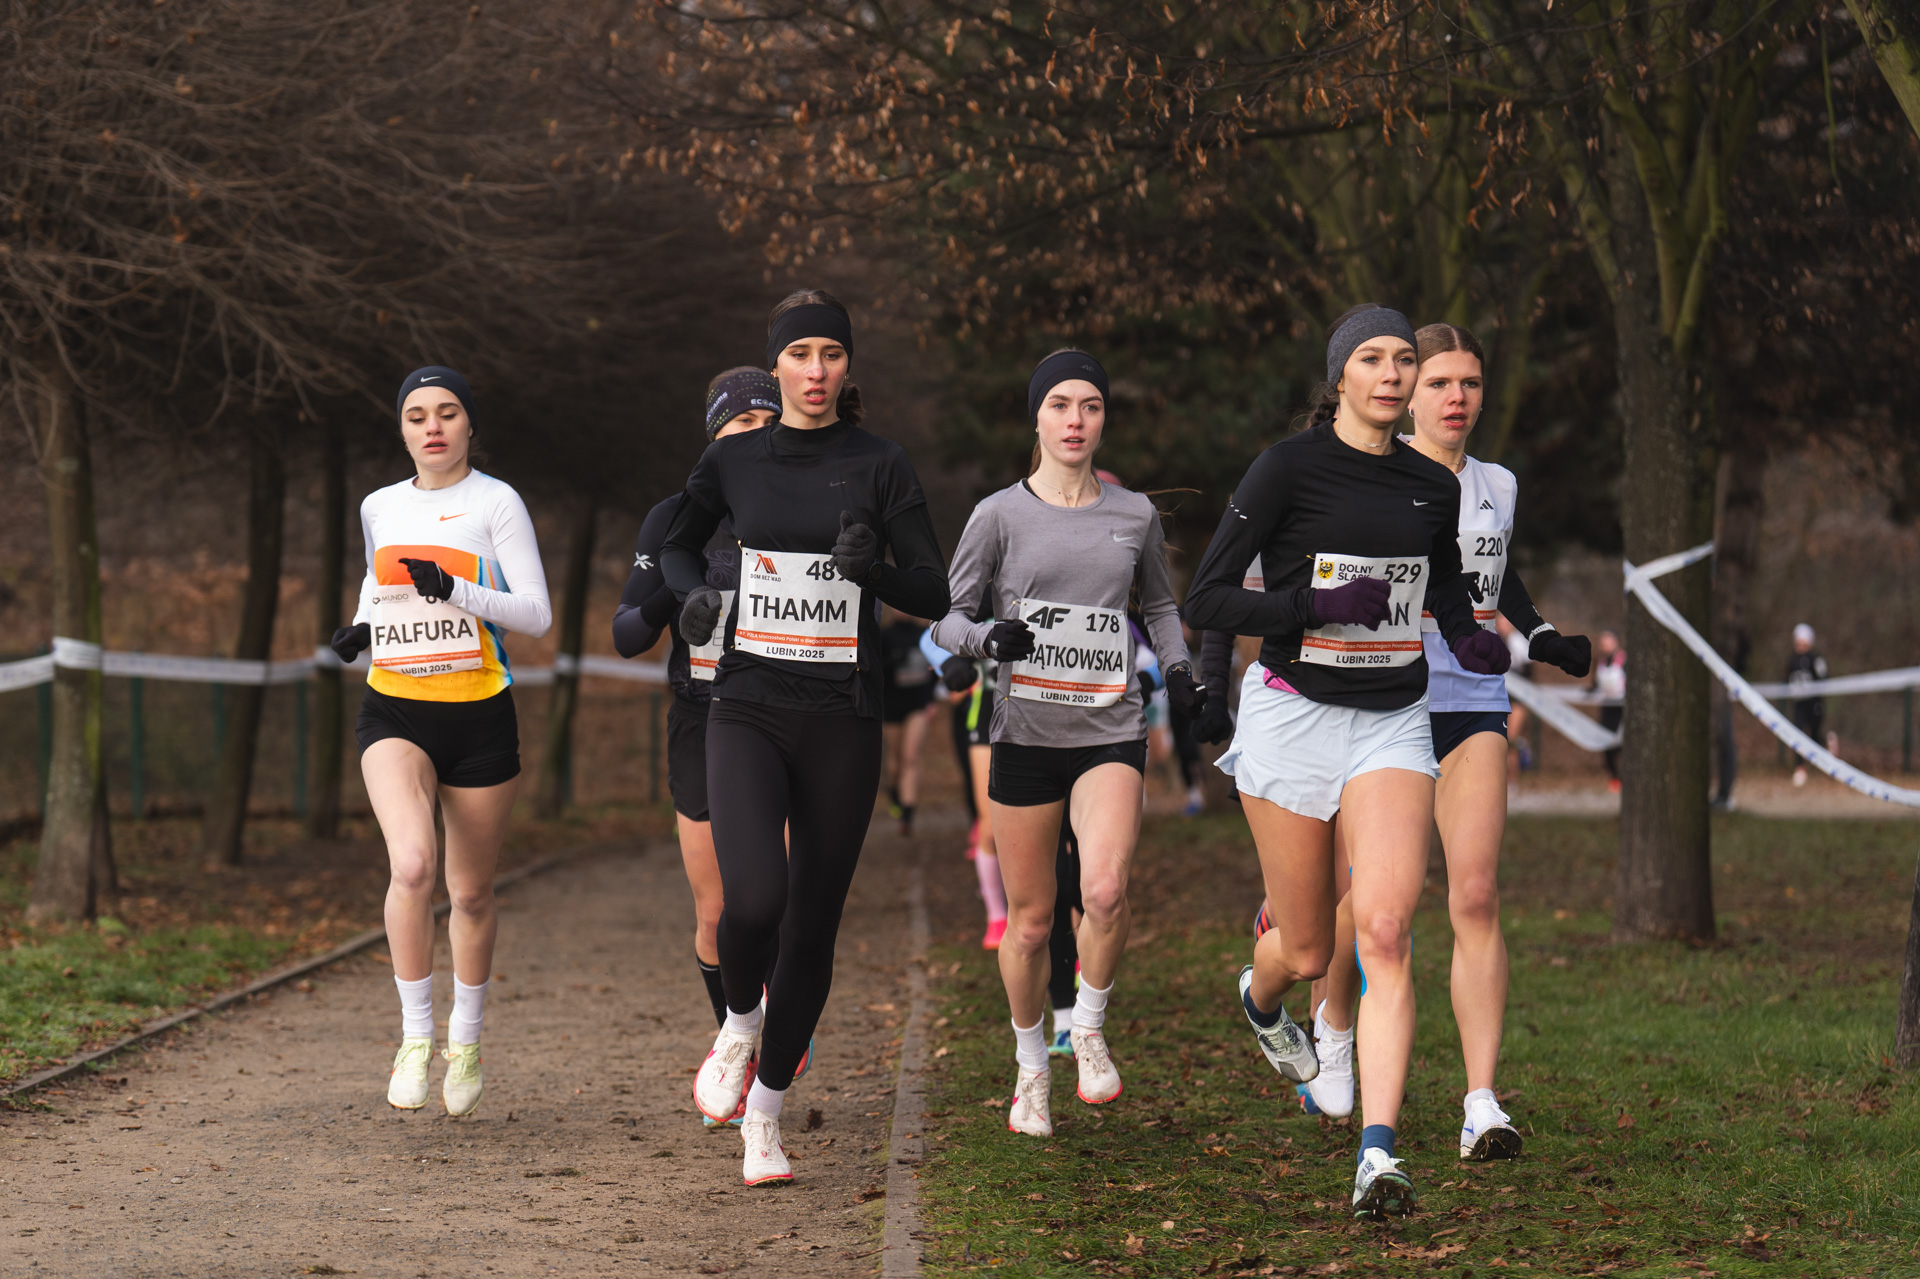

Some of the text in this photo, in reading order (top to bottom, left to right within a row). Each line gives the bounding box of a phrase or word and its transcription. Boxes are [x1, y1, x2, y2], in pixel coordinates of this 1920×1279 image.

[1474, 536, 1503, 556] 220
[806, 560, 845, 581] 48
[1339, 563, 1374, 575] DOLNY
[1382, 563, 1422, 584] 529
[381, 593, 409, 602] MUNDO
[749, 593, 847, 623] THAMM
[1026, 606, 1071, 630] 4F
[375, 618, 474, 646] FALFURA
[1086, 613, 1120, 634] 178
[766, 646, 826, 659] LUBIN 2025
[1019, 644, 1123, 672] IĄTKOWSKA
[1335, 654, 1392, 665] LUBIN 2025
[401, 663, 453, 675] LUBIN 2025
[1041, 691, 1096, 704] LUBIN 2025
